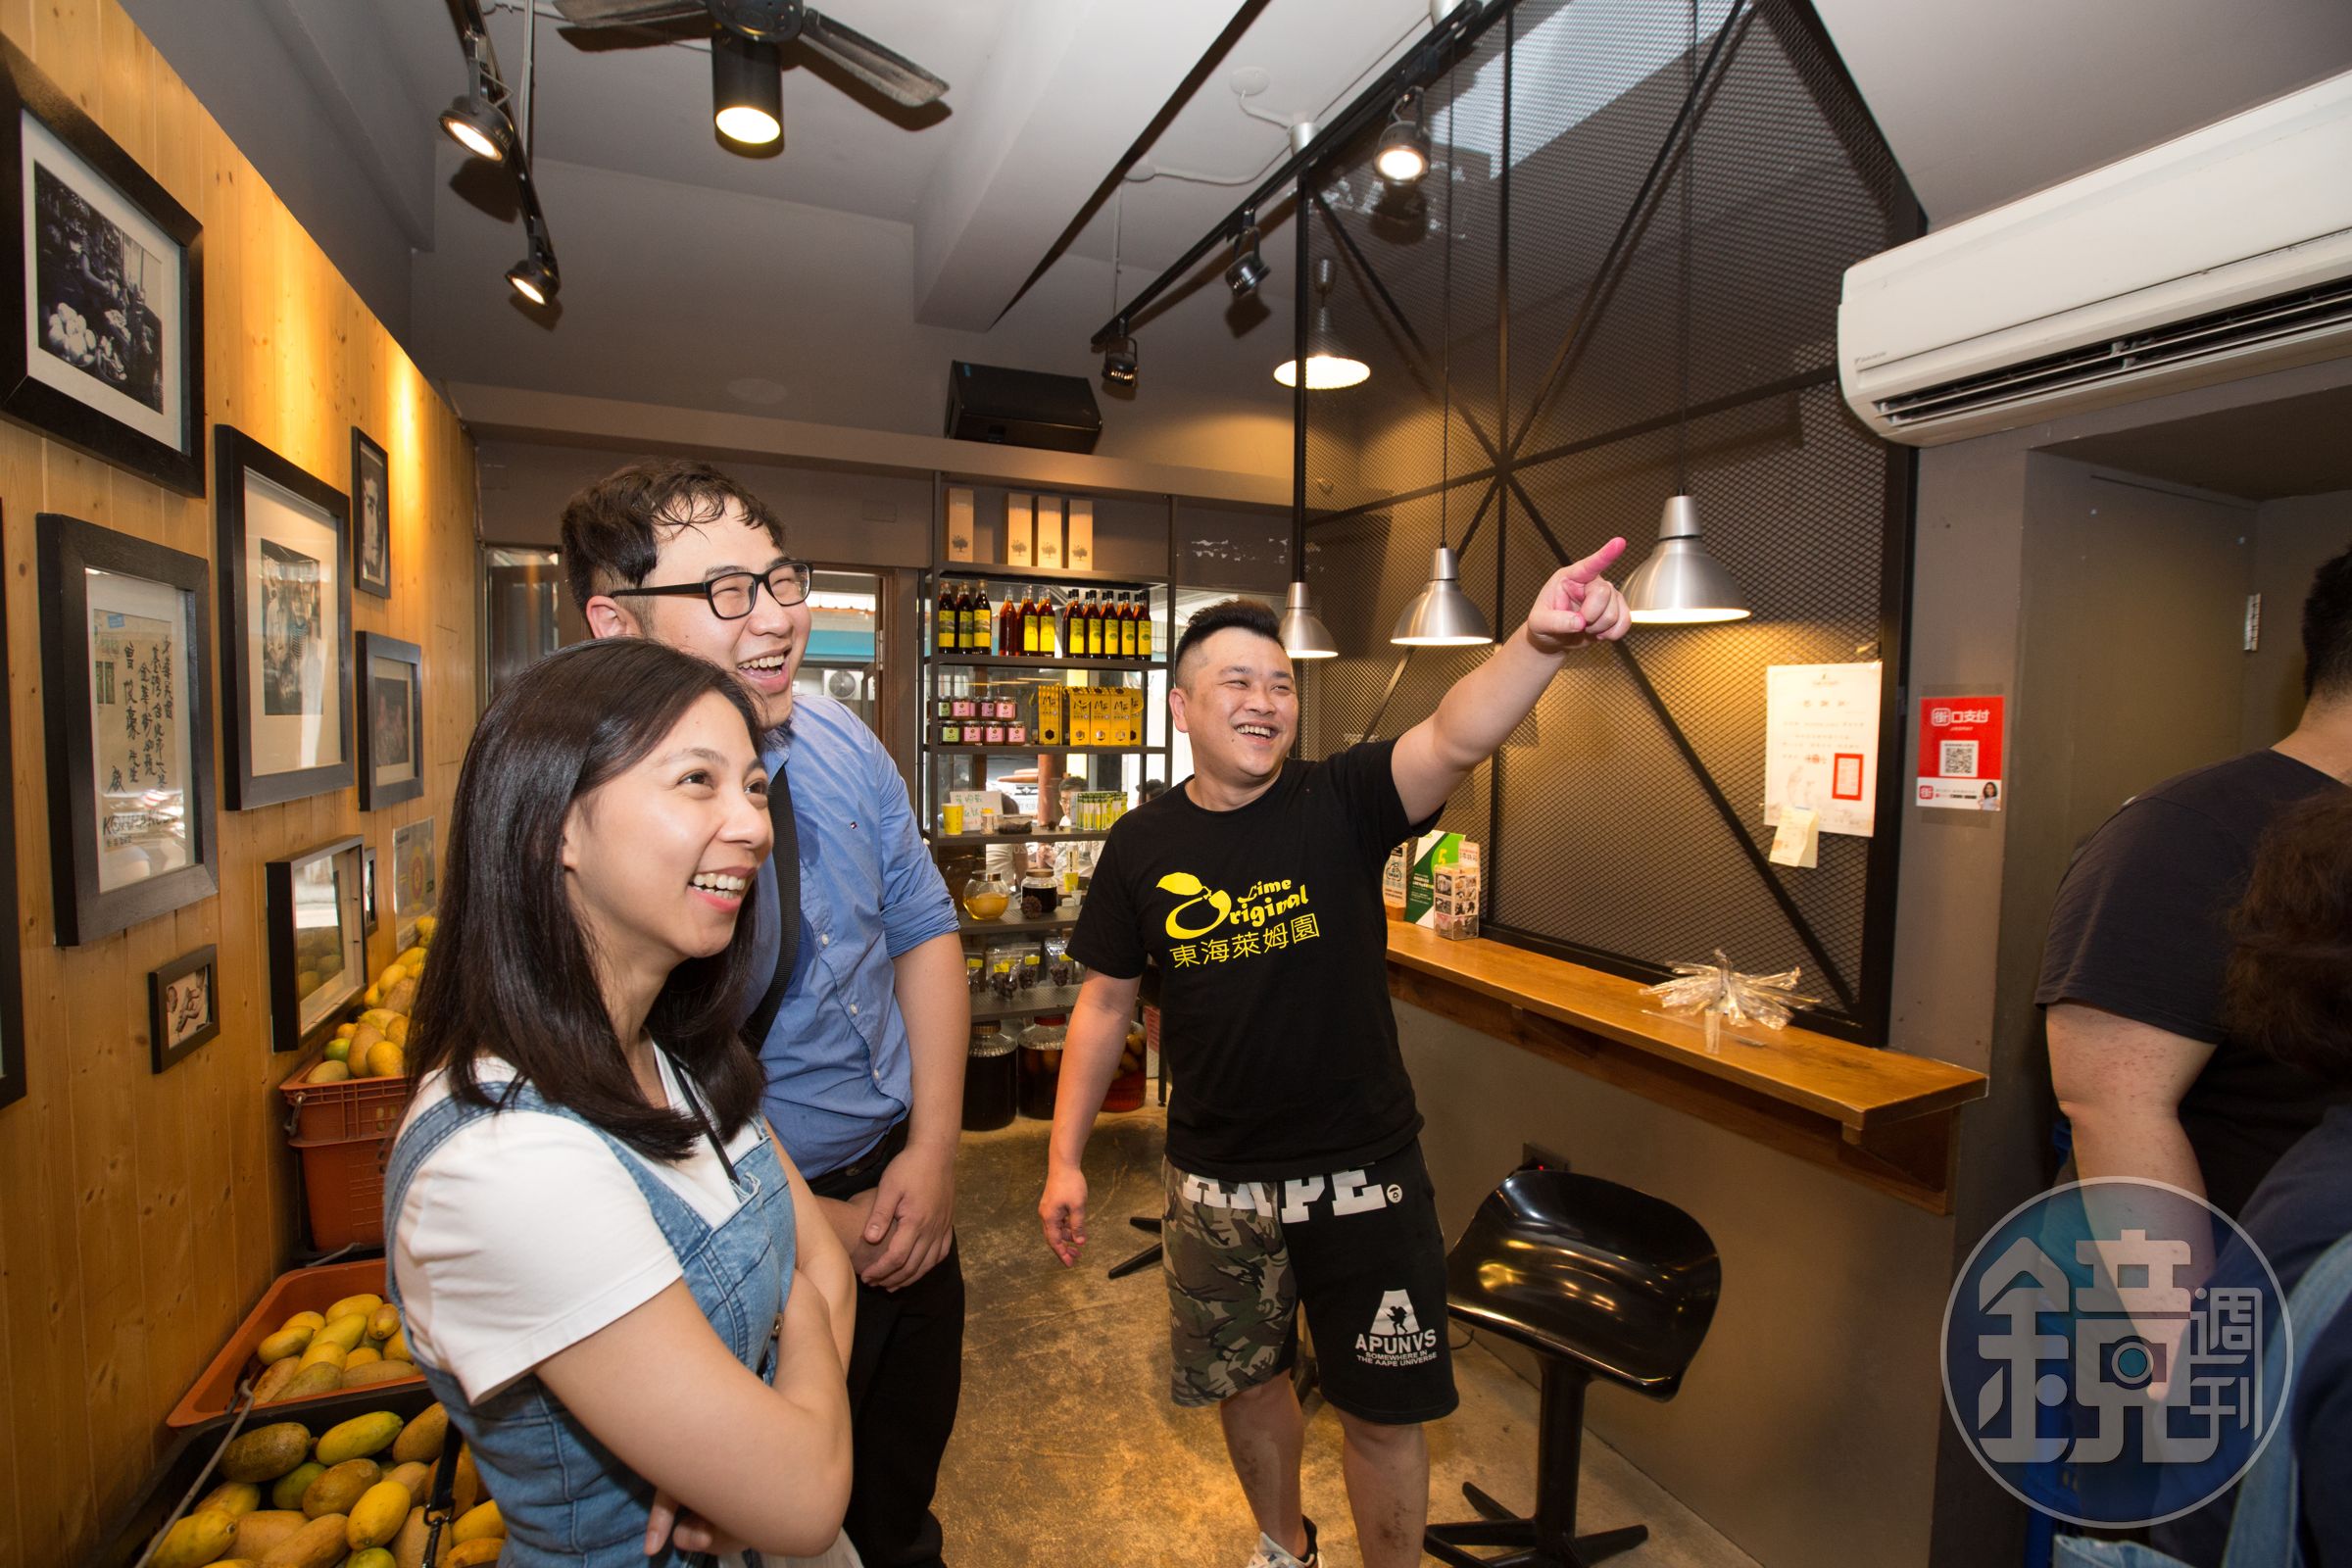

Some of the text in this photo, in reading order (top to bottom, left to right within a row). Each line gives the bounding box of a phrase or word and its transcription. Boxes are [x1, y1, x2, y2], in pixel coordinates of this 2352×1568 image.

[1164, 883, 1310, 941] Original
[1168, 912, 1321, 969] 東海萊姆園
[1354, 1328, 1438, 1354] APUNVS
[1356, 1351, 1438, 1367] THE AAPE UNIVERSE
[1365, 1350, 1418, 1361] SOMEWHERE
